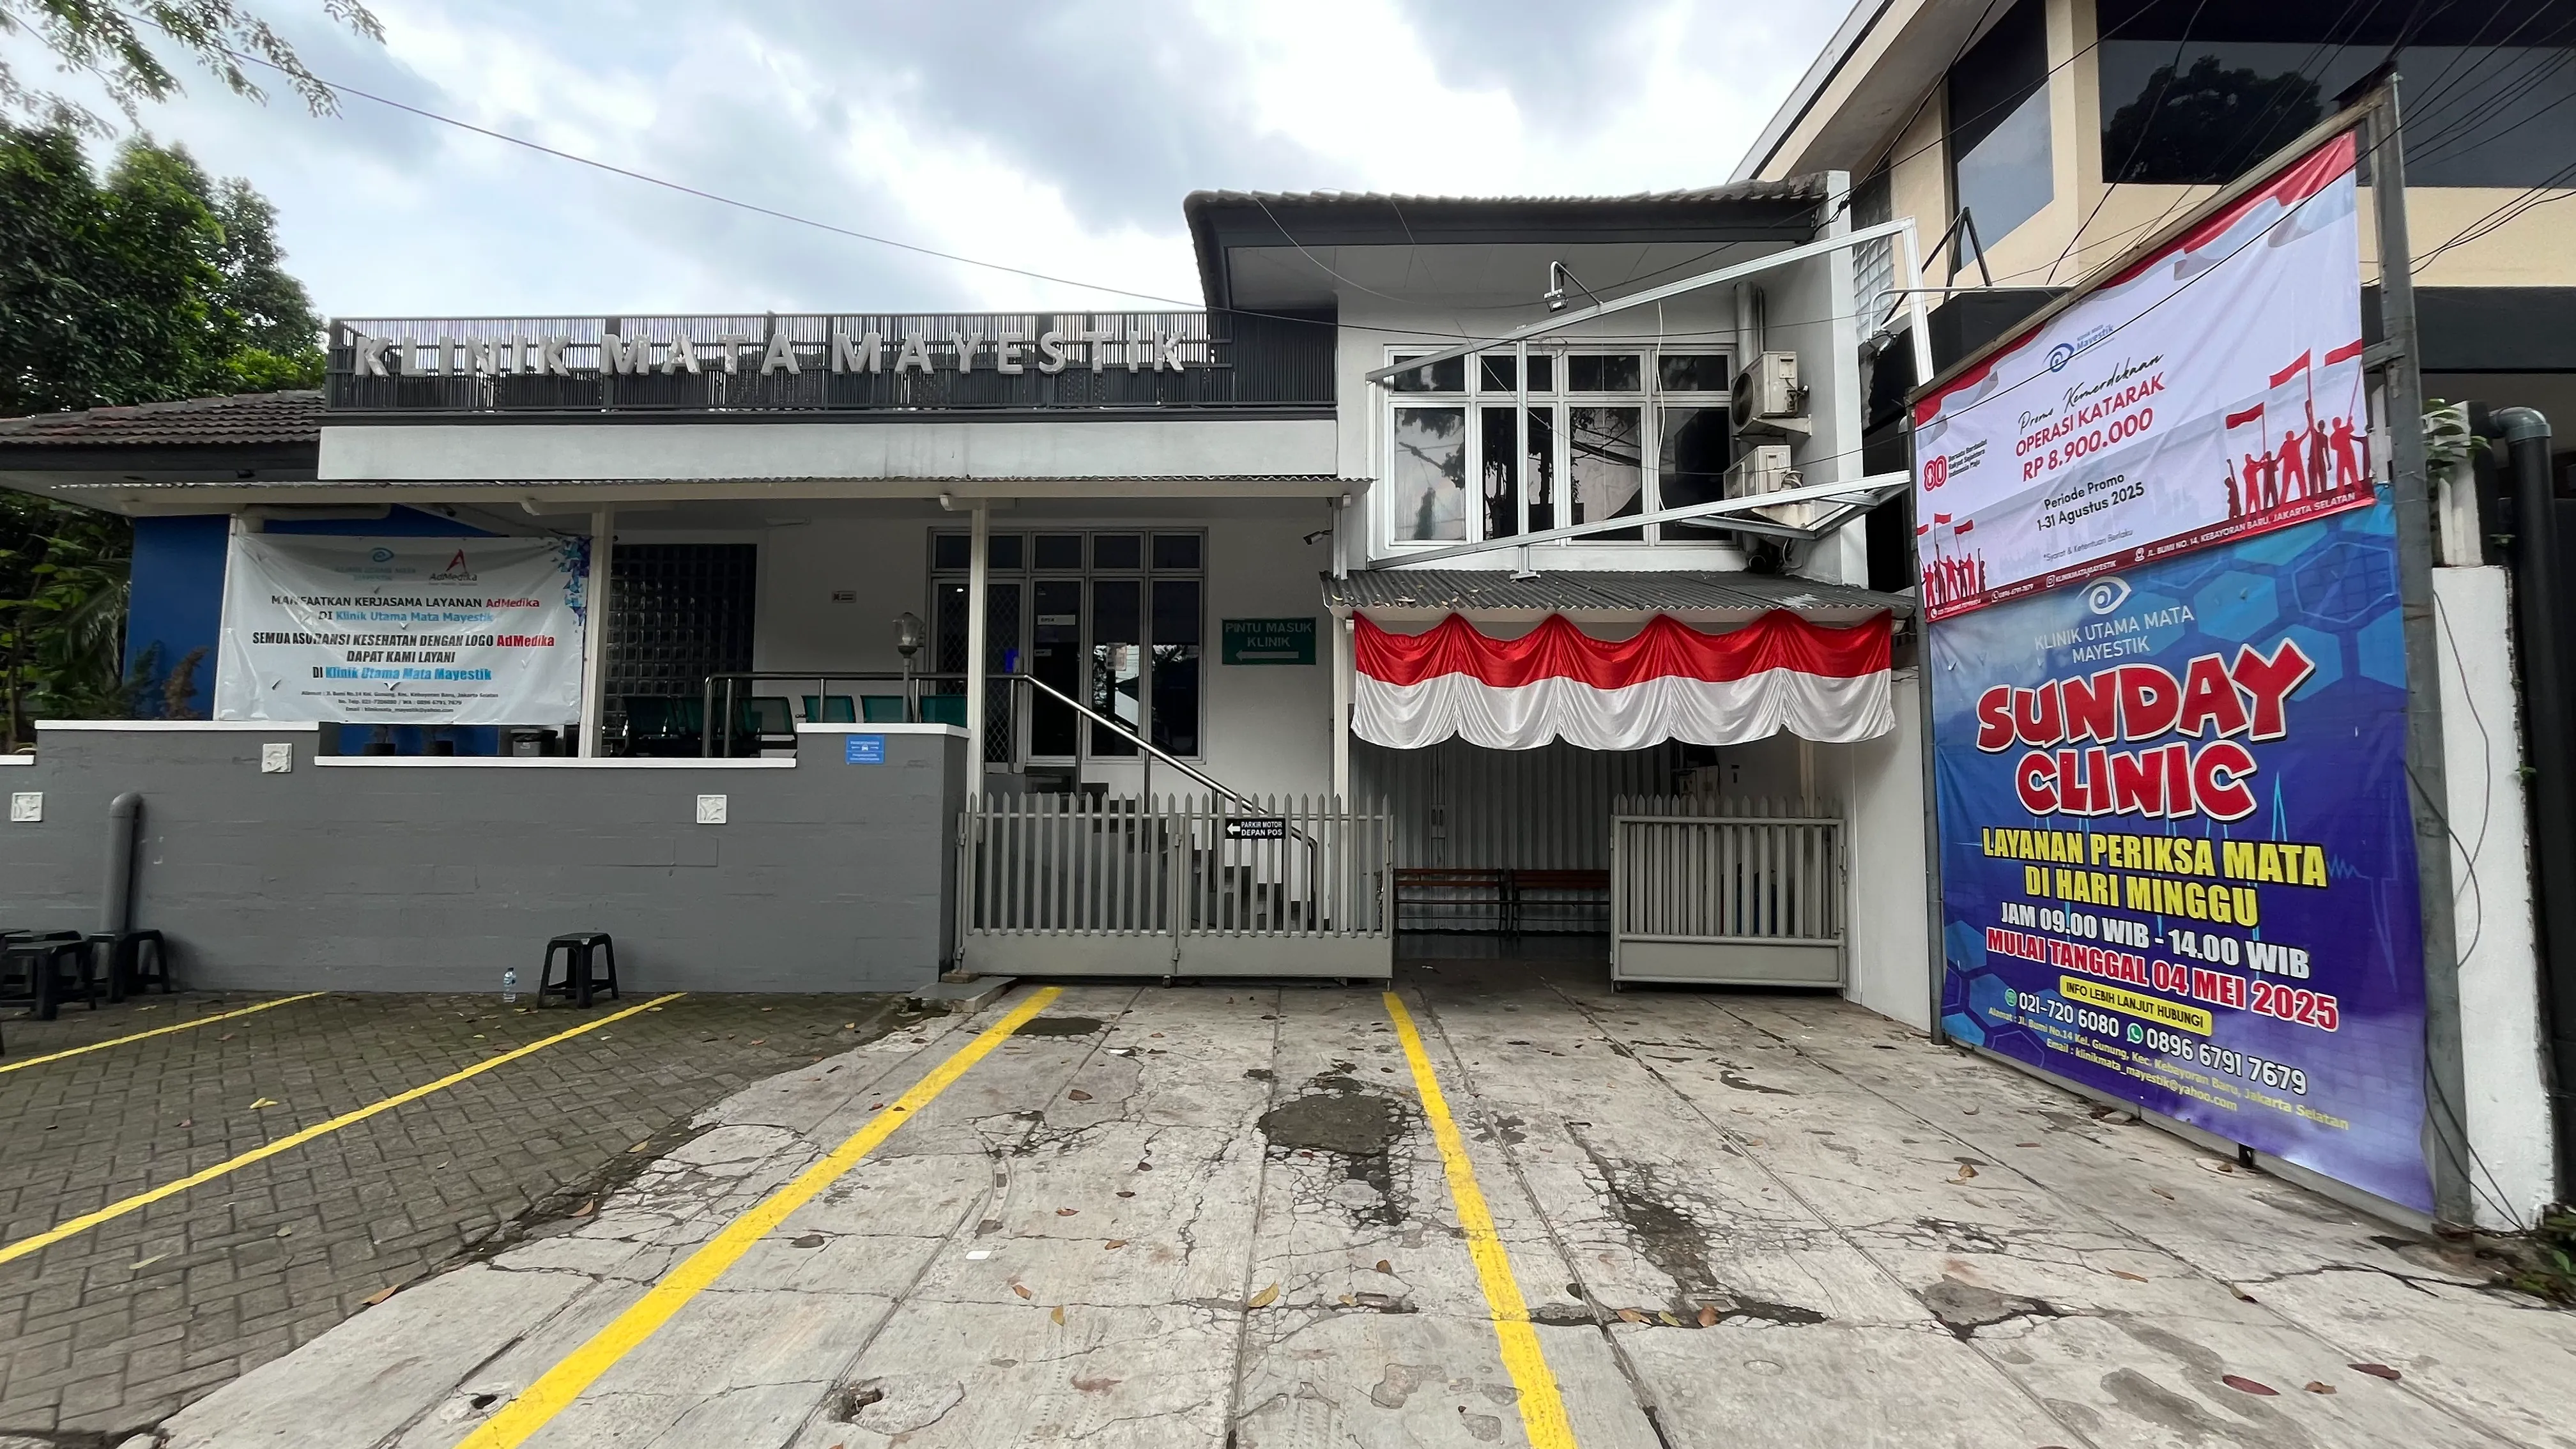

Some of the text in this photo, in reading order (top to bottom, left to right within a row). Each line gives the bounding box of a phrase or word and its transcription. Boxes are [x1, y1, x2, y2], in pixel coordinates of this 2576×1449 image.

[355, 330, 1186, 377] KLINIK MATA MAYESTIK
[2016, 371, 2165, 456] OPERASI KATARAK
[2018, 354, 2165, 435] Promo Kemerdekaan
[2023, 408, 2153, 482] RP 8.900.000
[1924, 455, 1947, 491] 80
[2044, 474, 2125, 510] Periode Promo
[2037, 482, 2145, 531] 1-31 Agustus 2025
[2200, 523, 2246, 542] KEBAYORAN
[2273, 504, 2312, 522] JAKARTA
[2314, 492, 2356, 510] SELATAN
[319, 611, 493, 624] DI Klinik Utama Mata Mayestik
[355, 597, 422, 607] KERJASAMA
[426, 598, 482, 608] LAYANAN
[486, 598, 540, 608] AdMedika
[252, 632, 290, 644] SEMUA
[353, 634, 417, 647] KESEHATAN
[419, 635, 463, 647] DENGAN
[465, 634, 493, 647] LOGO
[496, 635, 555, 647] AdMedika
[1225, 622, 1312, 633] PINTU MASUK
[1247, 637, 1291, 647] KLINIK
[2034, 605, 2195, 651] KLINIK UTAMA MATA
[2073, 636, 2150, 664] MAYESTIK
[312, 666, 492, 680] DI Klinik Utama Mata Mayestik
[347, 650, 456, 663] DAPAT KAMI LAYANI
[1976, 638, 2315, 753] SUNDAY
[2015, 739, 2257, 821] CLINIC
[1982, 827, 2328, 887] LAYANAN PERIKSA MATA
[2025, 865, 2258, 927] DI HARI MINGGU
[2002, 901, 2036, 928] JAM
[2039, 908, 2097, 939] 09.00
[2101, 917, 2150, 949] WIB
[2168, 929, 2240, 966] 14.00
[2244, 940, 2310, 979] WIB
[1986, 926, 2340, 1032] MULAI TANGGAL 04 MEI 2025
[2066, 982, 2204, 1029] INFO LEBIH LANJUT HUBUNGI
[2019, 992, 2308, 1096] 021-720 6080 0896 6791 7679
[2046, 1039, 2069, 1054] Email
[2049, 1026, 2073, 1041] No.14
[2074, 1033, 2090, 1047] Kel.
[2131, 1052, 2152, 1068] Kec.
[2154, 1057, 2209, 1085] Kebayoran
[2244, 1089, 2292, 1113] Jakarta
[2296, 1104, 2349, 1131] Selatan
